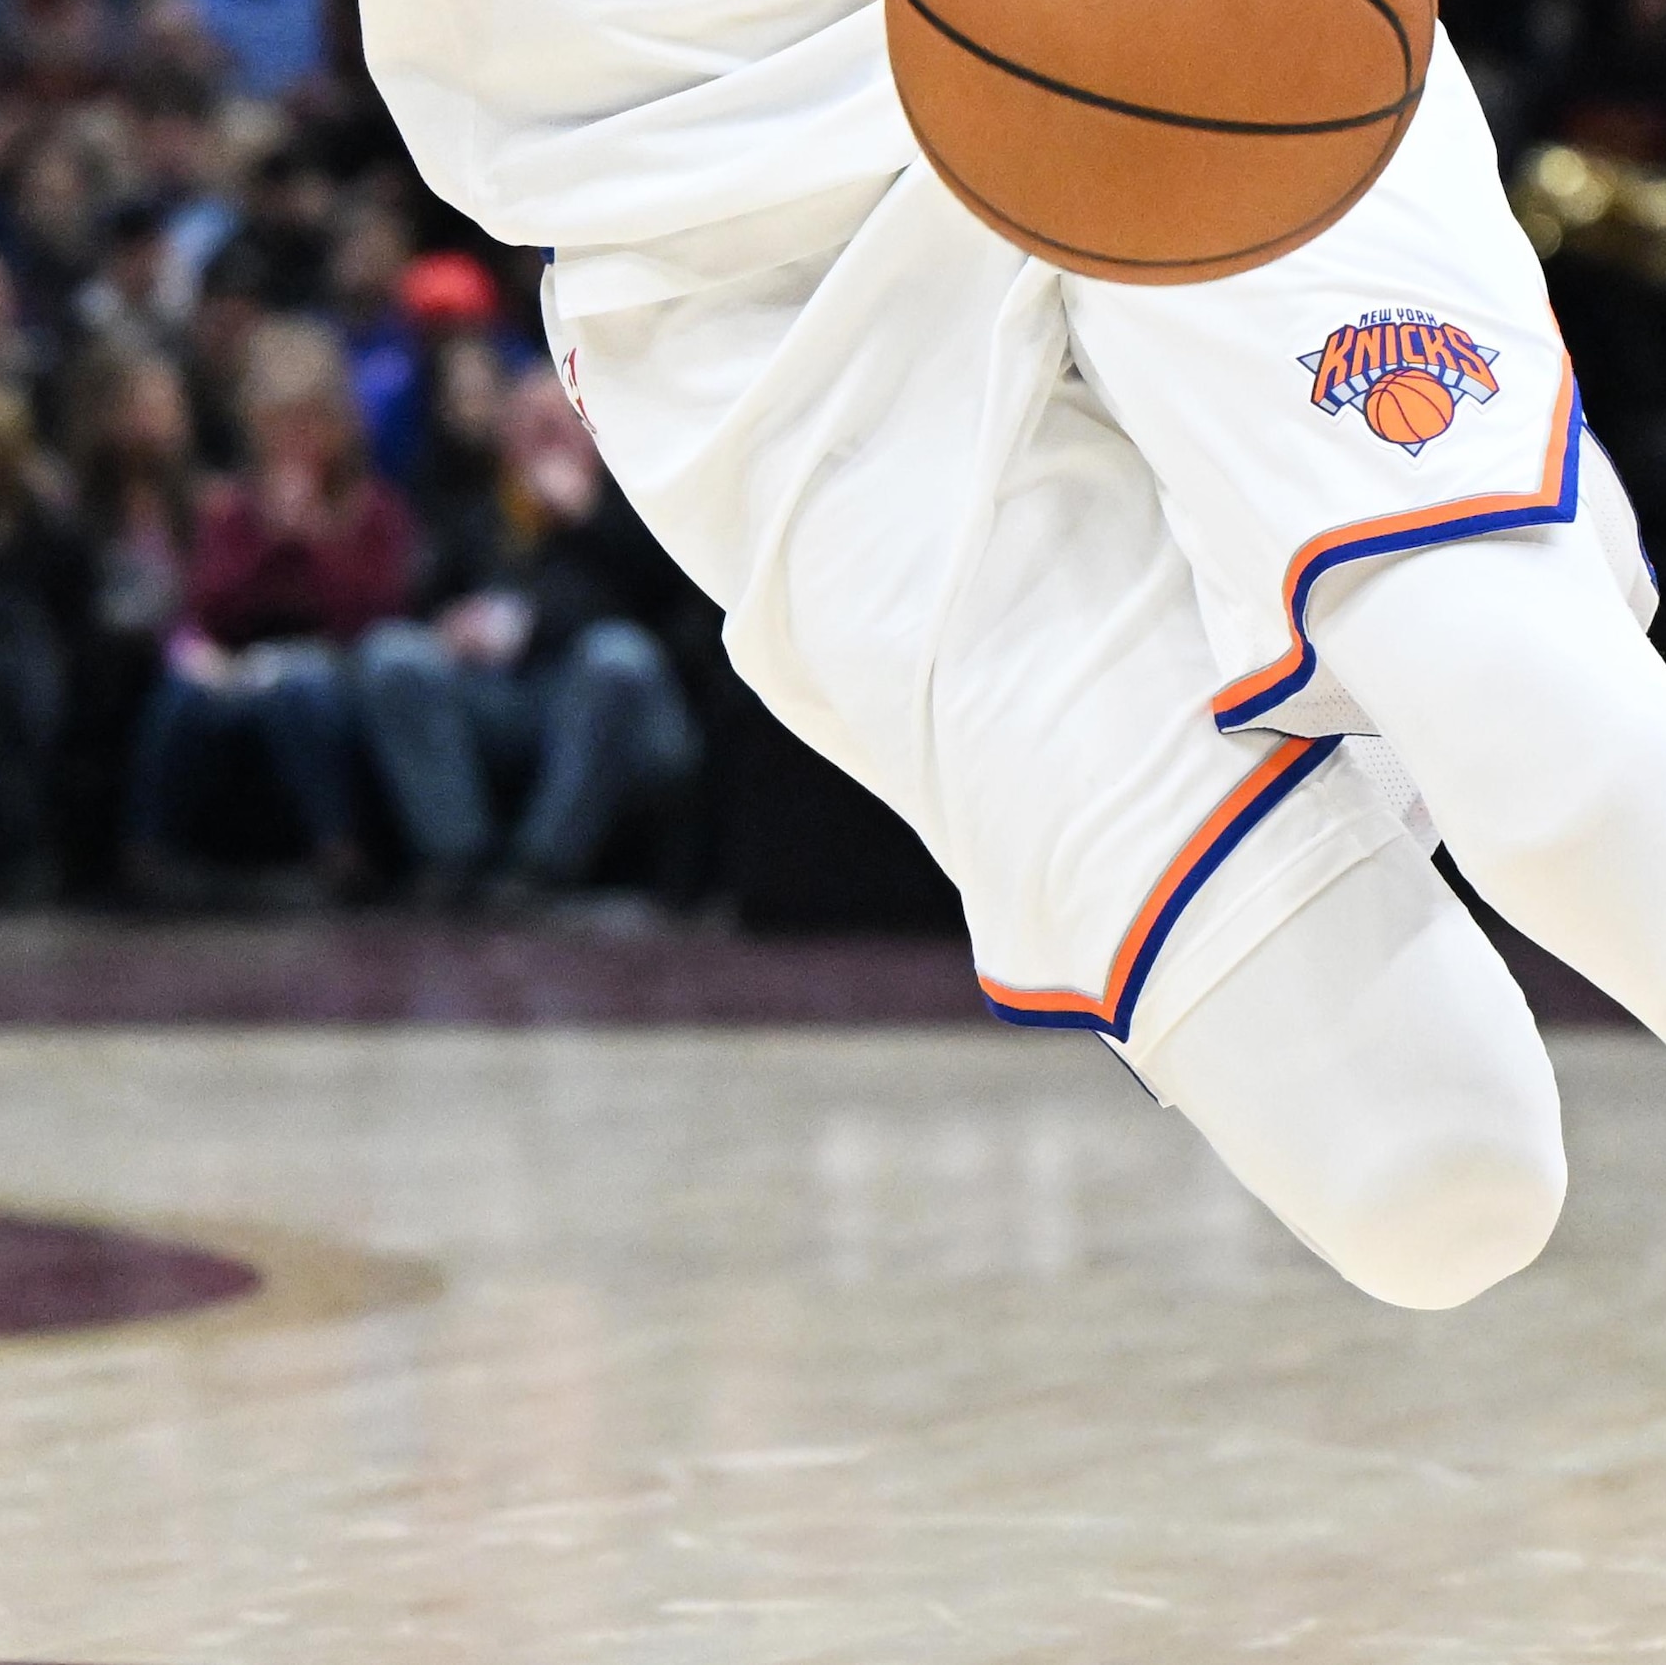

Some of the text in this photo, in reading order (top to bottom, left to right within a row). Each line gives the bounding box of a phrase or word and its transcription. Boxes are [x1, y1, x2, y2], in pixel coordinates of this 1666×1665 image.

[1358, 307, 1439, 327] NEW YORK
[1310, 321, 1500, 417] KNICKS
